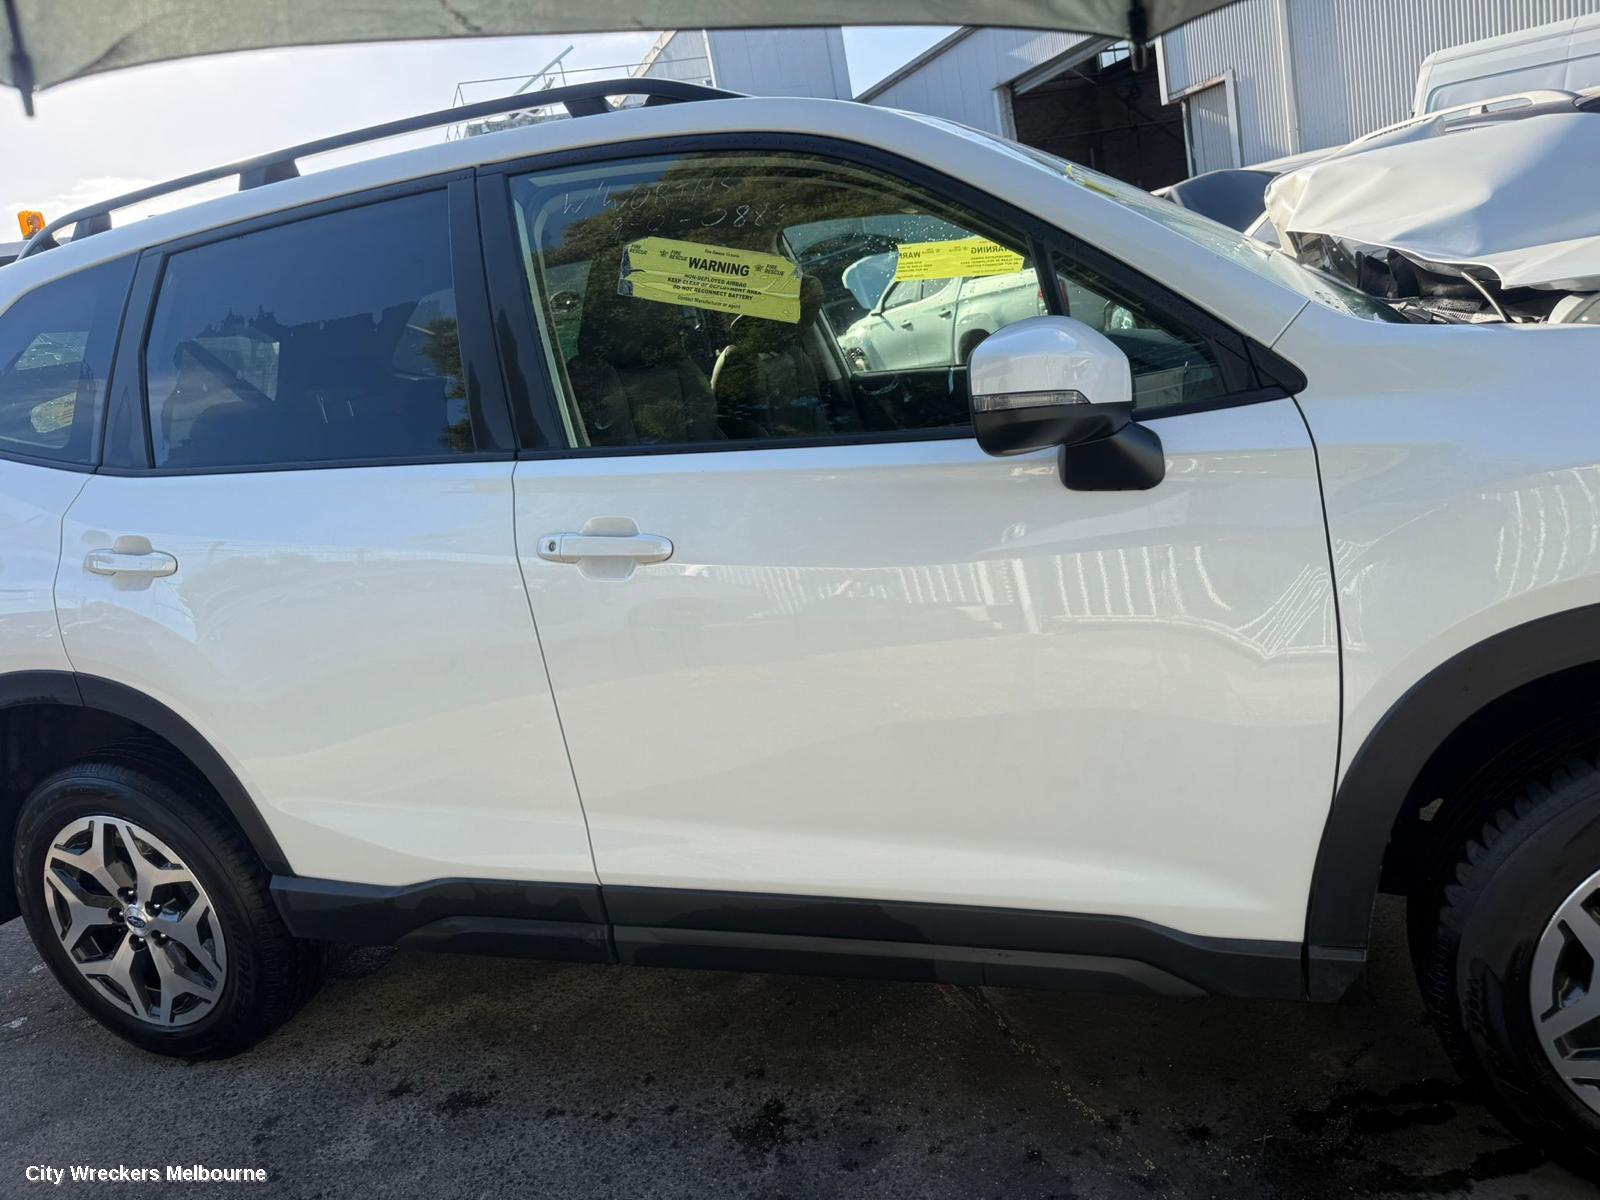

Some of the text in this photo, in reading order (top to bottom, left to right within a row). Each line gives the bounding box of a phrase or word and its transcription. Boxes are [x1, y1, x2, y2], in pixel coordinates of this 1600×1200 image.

[688, 256, 750, 277] WARNING
[694, 287, 727, 297] RECONNECT
[728, 292, 753, 300] BATTERY
